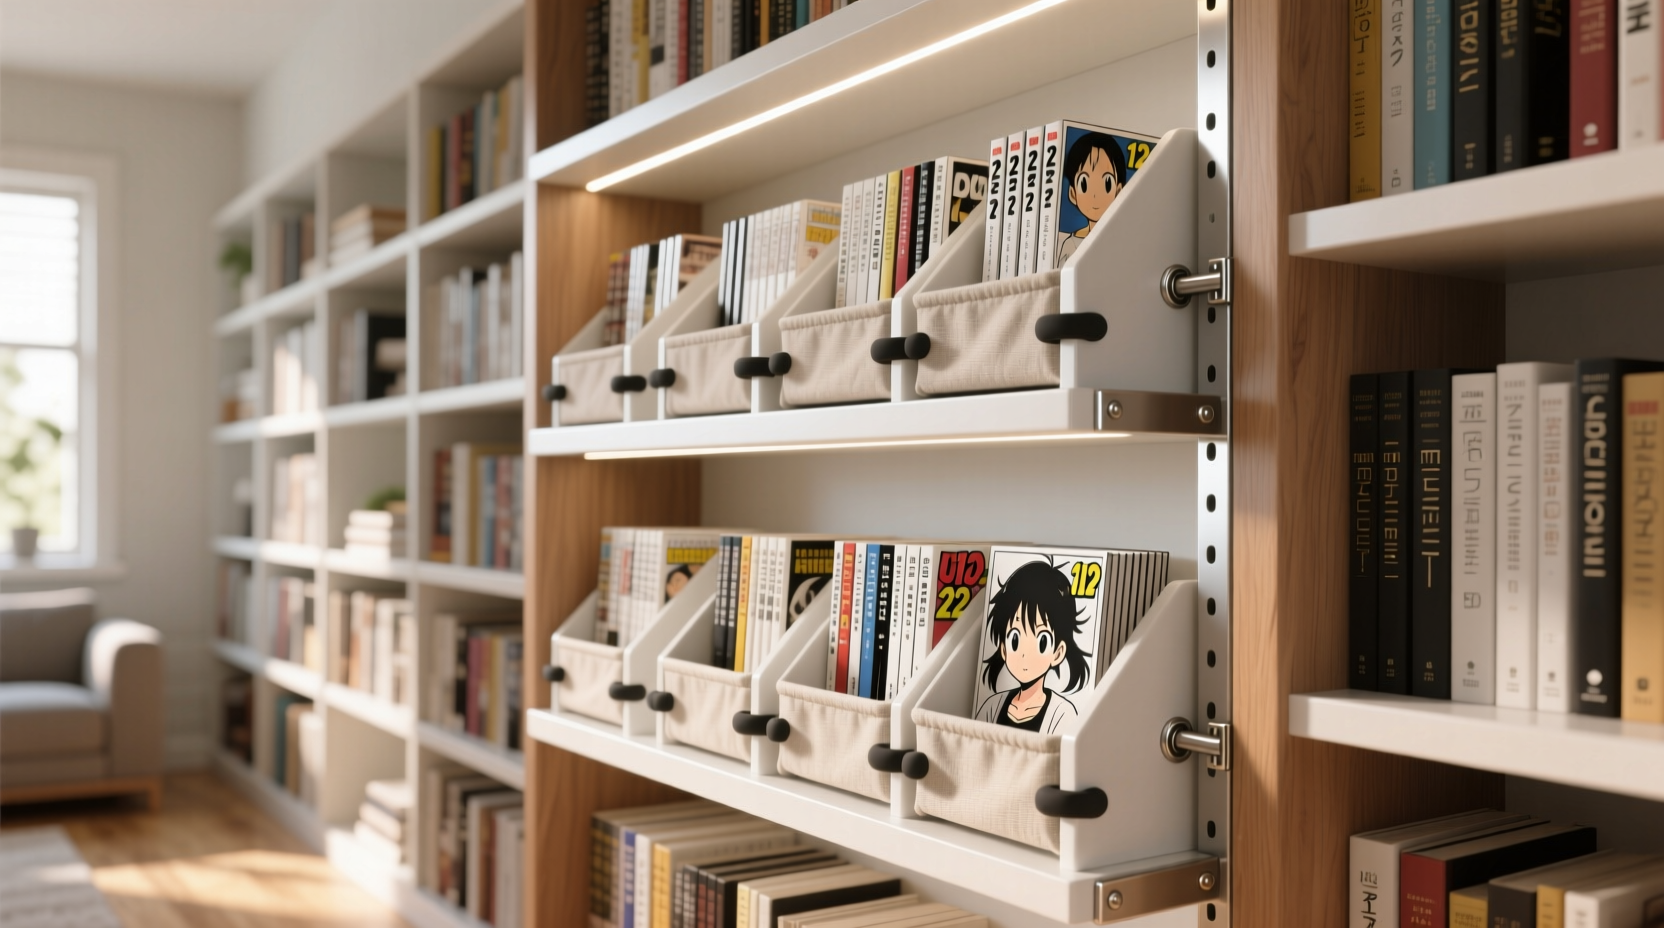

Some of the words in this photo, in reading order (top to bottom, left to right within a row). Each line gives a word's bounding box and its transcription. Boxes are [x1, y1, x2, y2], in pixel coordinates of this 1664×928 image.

[1127, 142, 1150, 169] 12
[1071, 561, 1102, 598] 112
[935, 586, 971, 619] 22
